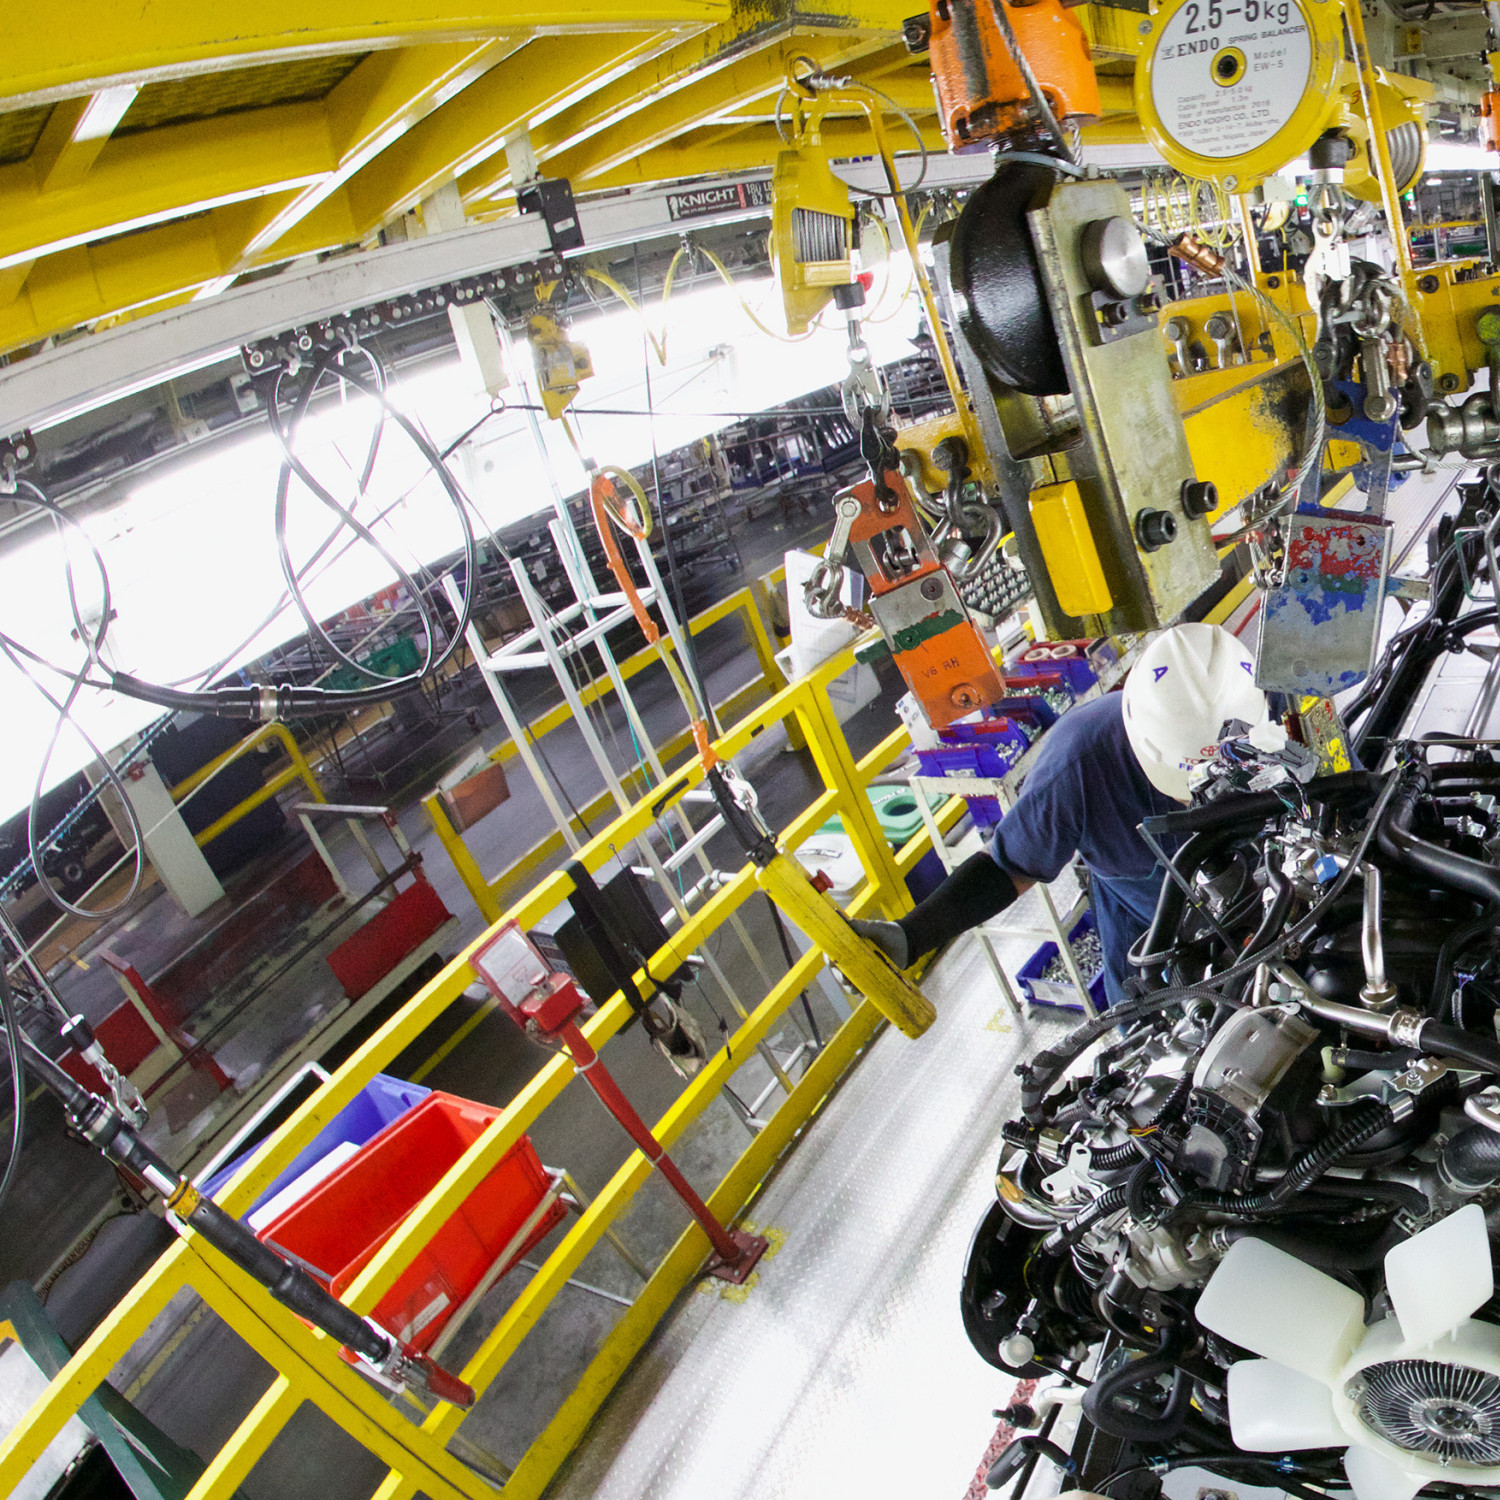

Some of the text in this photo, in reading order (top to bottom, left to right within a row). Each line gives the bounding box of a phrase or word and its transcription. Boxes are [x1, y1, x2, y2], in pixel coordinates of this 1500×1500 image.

[1177, 24, 1306, 57] ENDO SPRING BALANCER
[1254, 49, 1287, 59] Model
[1254, 61, 1283, 71] EW-5
[1179, 120, 1201, 129] ENDO
[1204, 115, 1230, 125] KOGYO
[746, 180, 773, 195] 180 LB
[679, 188, 735, 208] KNIGHT
[752, 194, 764, 205] 82
[921, 657, 960, 678] V6 RH
[1153, 666, 1168, 683] A
